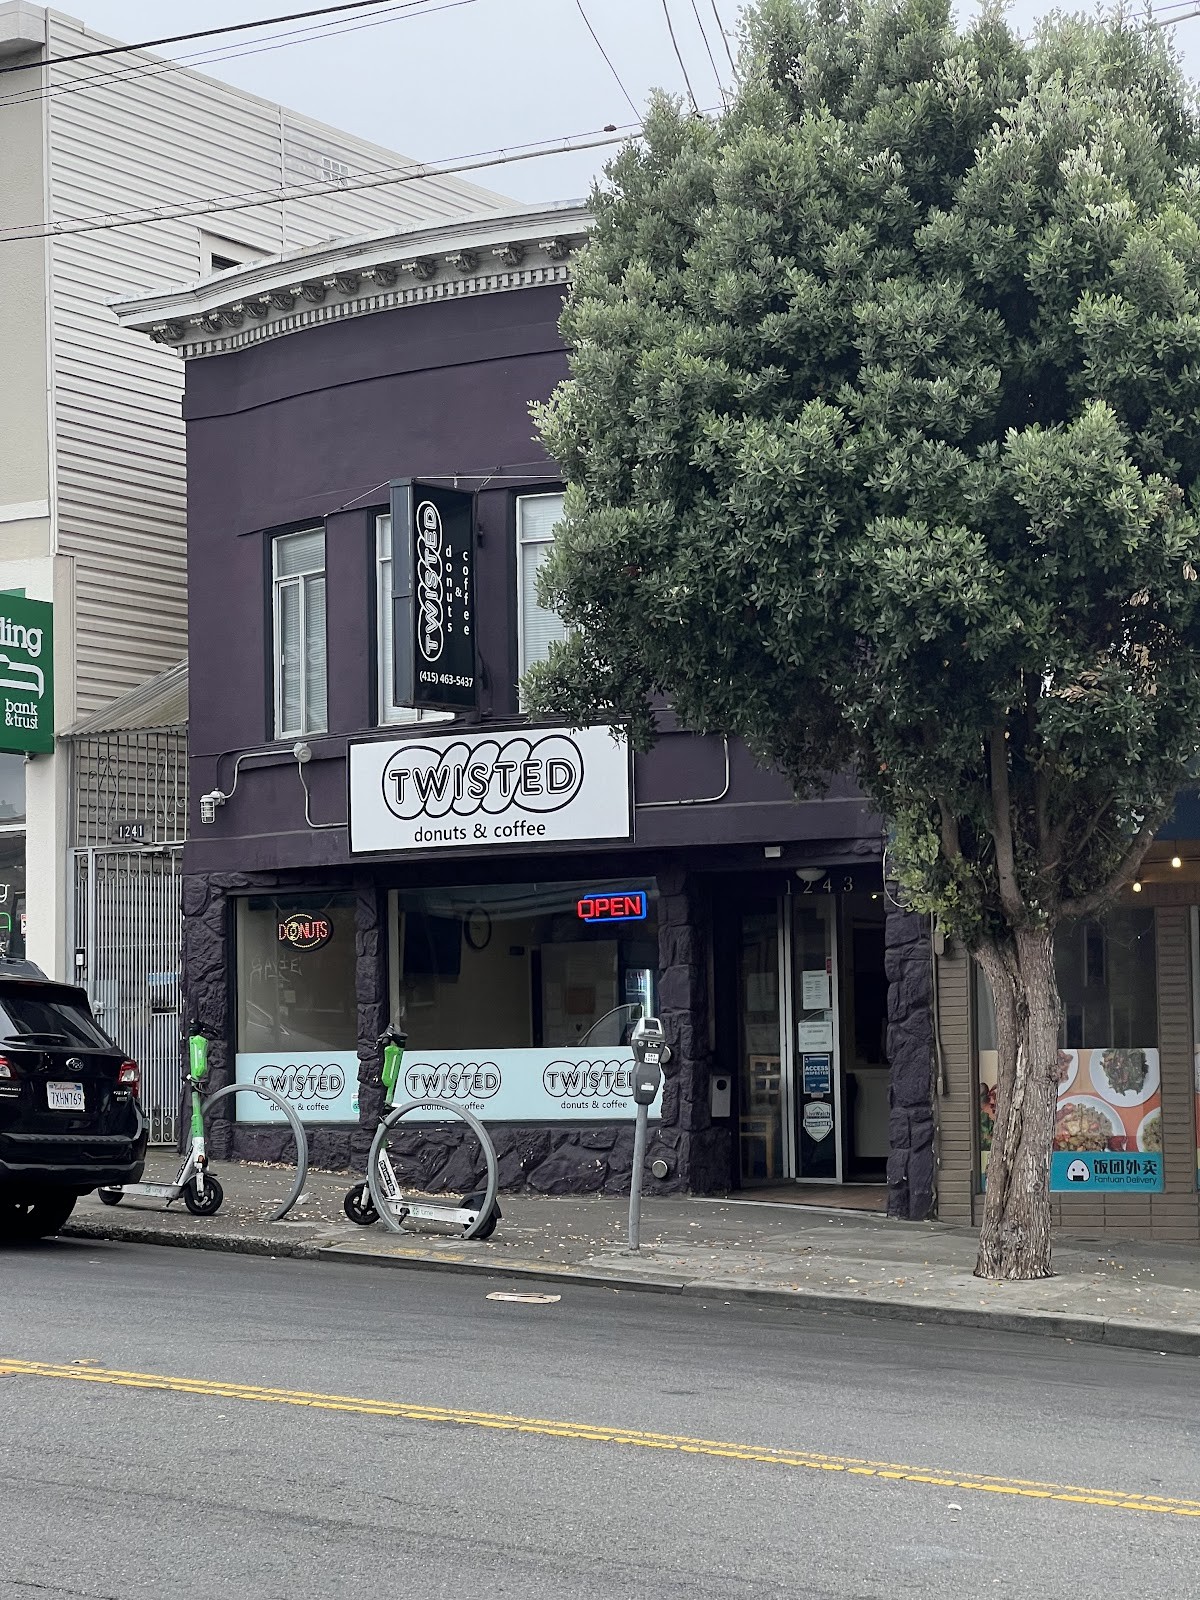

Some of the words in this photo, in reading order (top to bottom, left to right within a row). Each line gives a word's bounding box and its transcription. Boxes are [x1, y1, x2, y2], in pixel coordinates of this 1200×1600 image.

[424, 506, 439, 655] TWISTED
[455, 586, 463, 598] &
[462, 551, 470, 636] coffee
[419, 670, 439, 685] (415)
[440, 673, 474, 688] 463-5437
[5, 698, 38, 716] bank
[389, 757, 577, 804] TWISTED
[119, 824, 143, 838] 1241
[414, 826, 467, 842] donuts
[473, 823, 488, 839] &
[494, 820, 546, 838] coffee
[577, 896, 641, 918] OPEN
[278, 920, 328, 941] DONUTS
[258, 1073, 343, 1093] TWISTED
[408, 1073, 498, 1092] TWISTED
[50, 1092, 82, 1105] 7XHN769
[297, 1103, 304, 1111] &
[306, 1102, 330, 1111] coffee
[560, 1101, 589, 1109] donuts
[591, 1100, 599, 1109] &
[601, 1100, 628, 1109] coffee
[1094, 1159, 1158, 1175] 饭团外卖
[1094, 1175, 1124, 1184] Fantuan
[1126, 1176, 1157, 1186] Delivery
